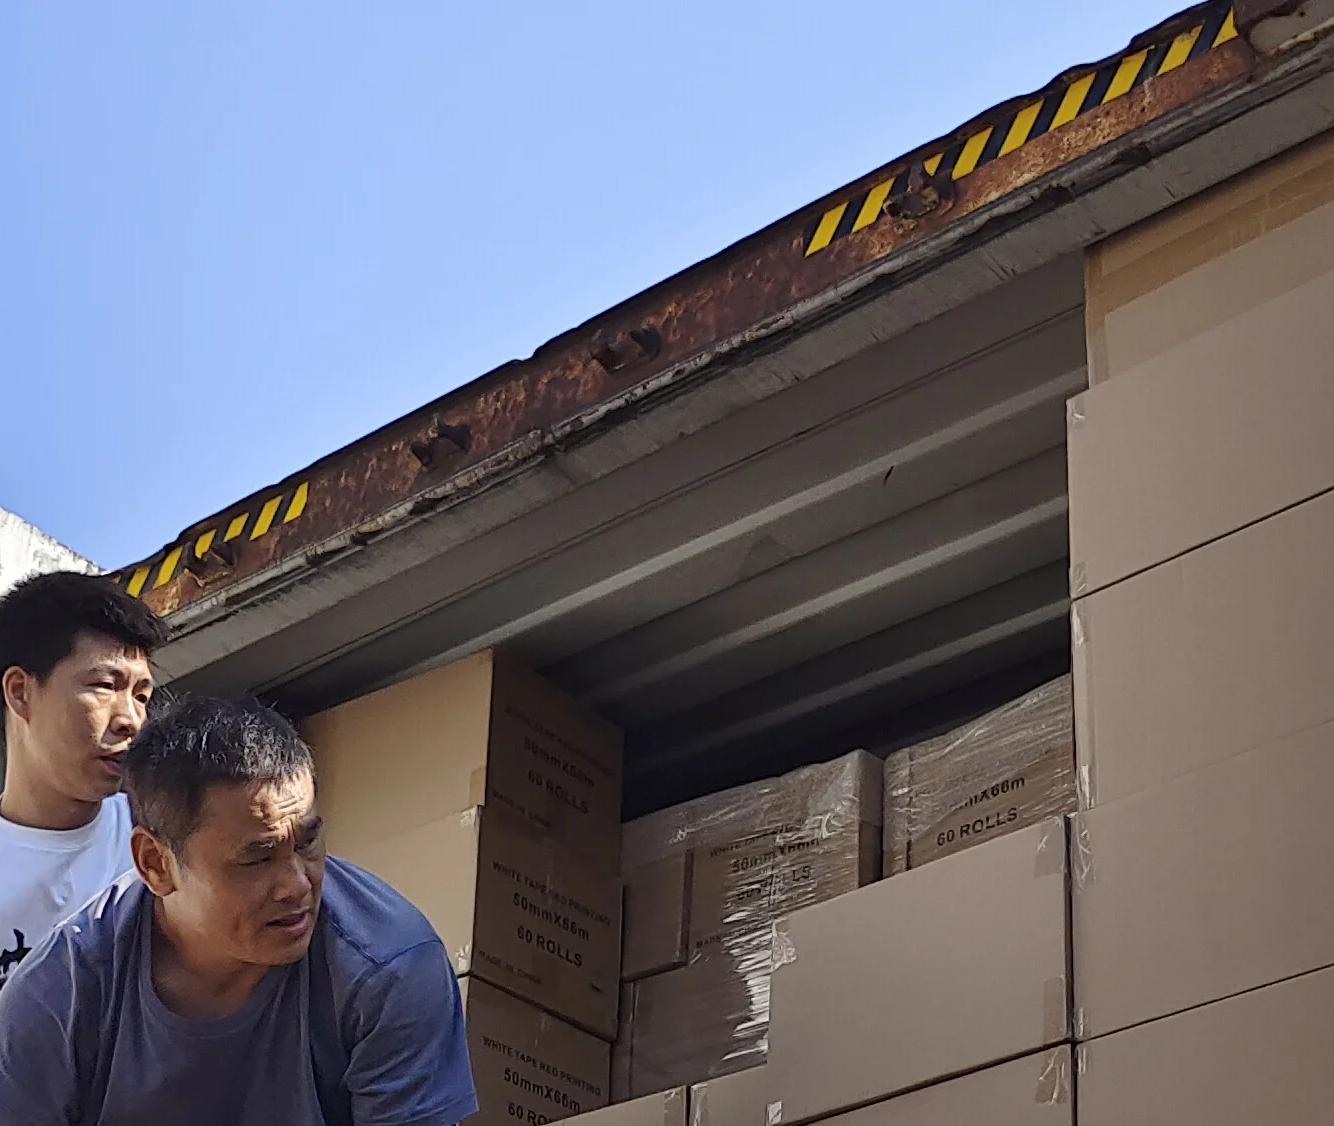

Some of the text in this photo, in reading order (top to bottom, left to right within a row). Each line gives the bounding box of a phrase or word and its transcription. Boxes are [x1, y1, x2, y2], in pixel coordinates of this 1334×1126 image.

[528, 769, 589, 815] 60 ROLLS
[936, 807, 1018, 847] 60 ROLLS
[492, 860, 521, 882] WHITE
[524, 876, 547, 895] TAPE
[512, 892, 590, 941] 50mmX66m
[516, 925, 584, 968] 60 ROLLS
[482, 1035, 602, 1097] WHITE TAPE RED PRINTING
[503, 1067, 581, 1115] 50mmX66m
[507, 1101, 524, 1120] 60
